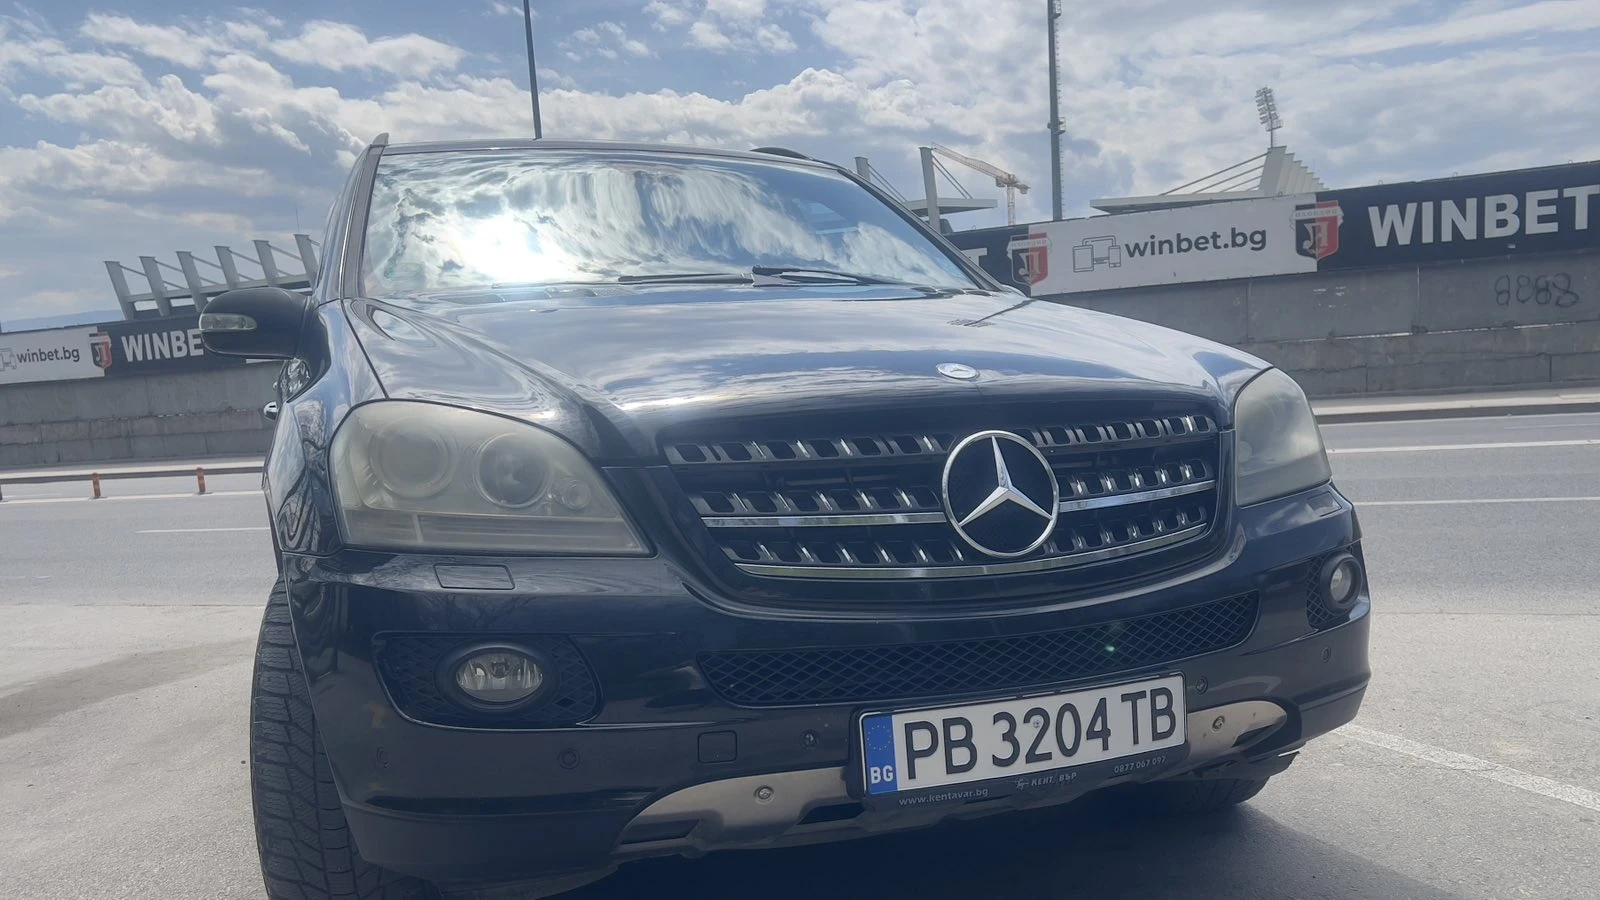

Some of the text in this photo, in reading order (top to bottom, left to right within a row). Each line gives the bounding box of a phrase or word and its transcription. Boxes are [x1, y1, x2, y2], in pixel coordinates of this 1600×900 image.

[1368, 184, 1600, 248] WINBET
[1124, 227, 1267, 258] winbet.bg
[17, 346, 80, 363] winbet.bg
[121, 328, 204, 362] WINBE
[904, 687, 1177, 780] PB 3204 TB
[870, 765, 894, 784] BG
[1114, 762, 1134, 773] 0877
[899, 788, 989, 806] www.kentavar.bg
